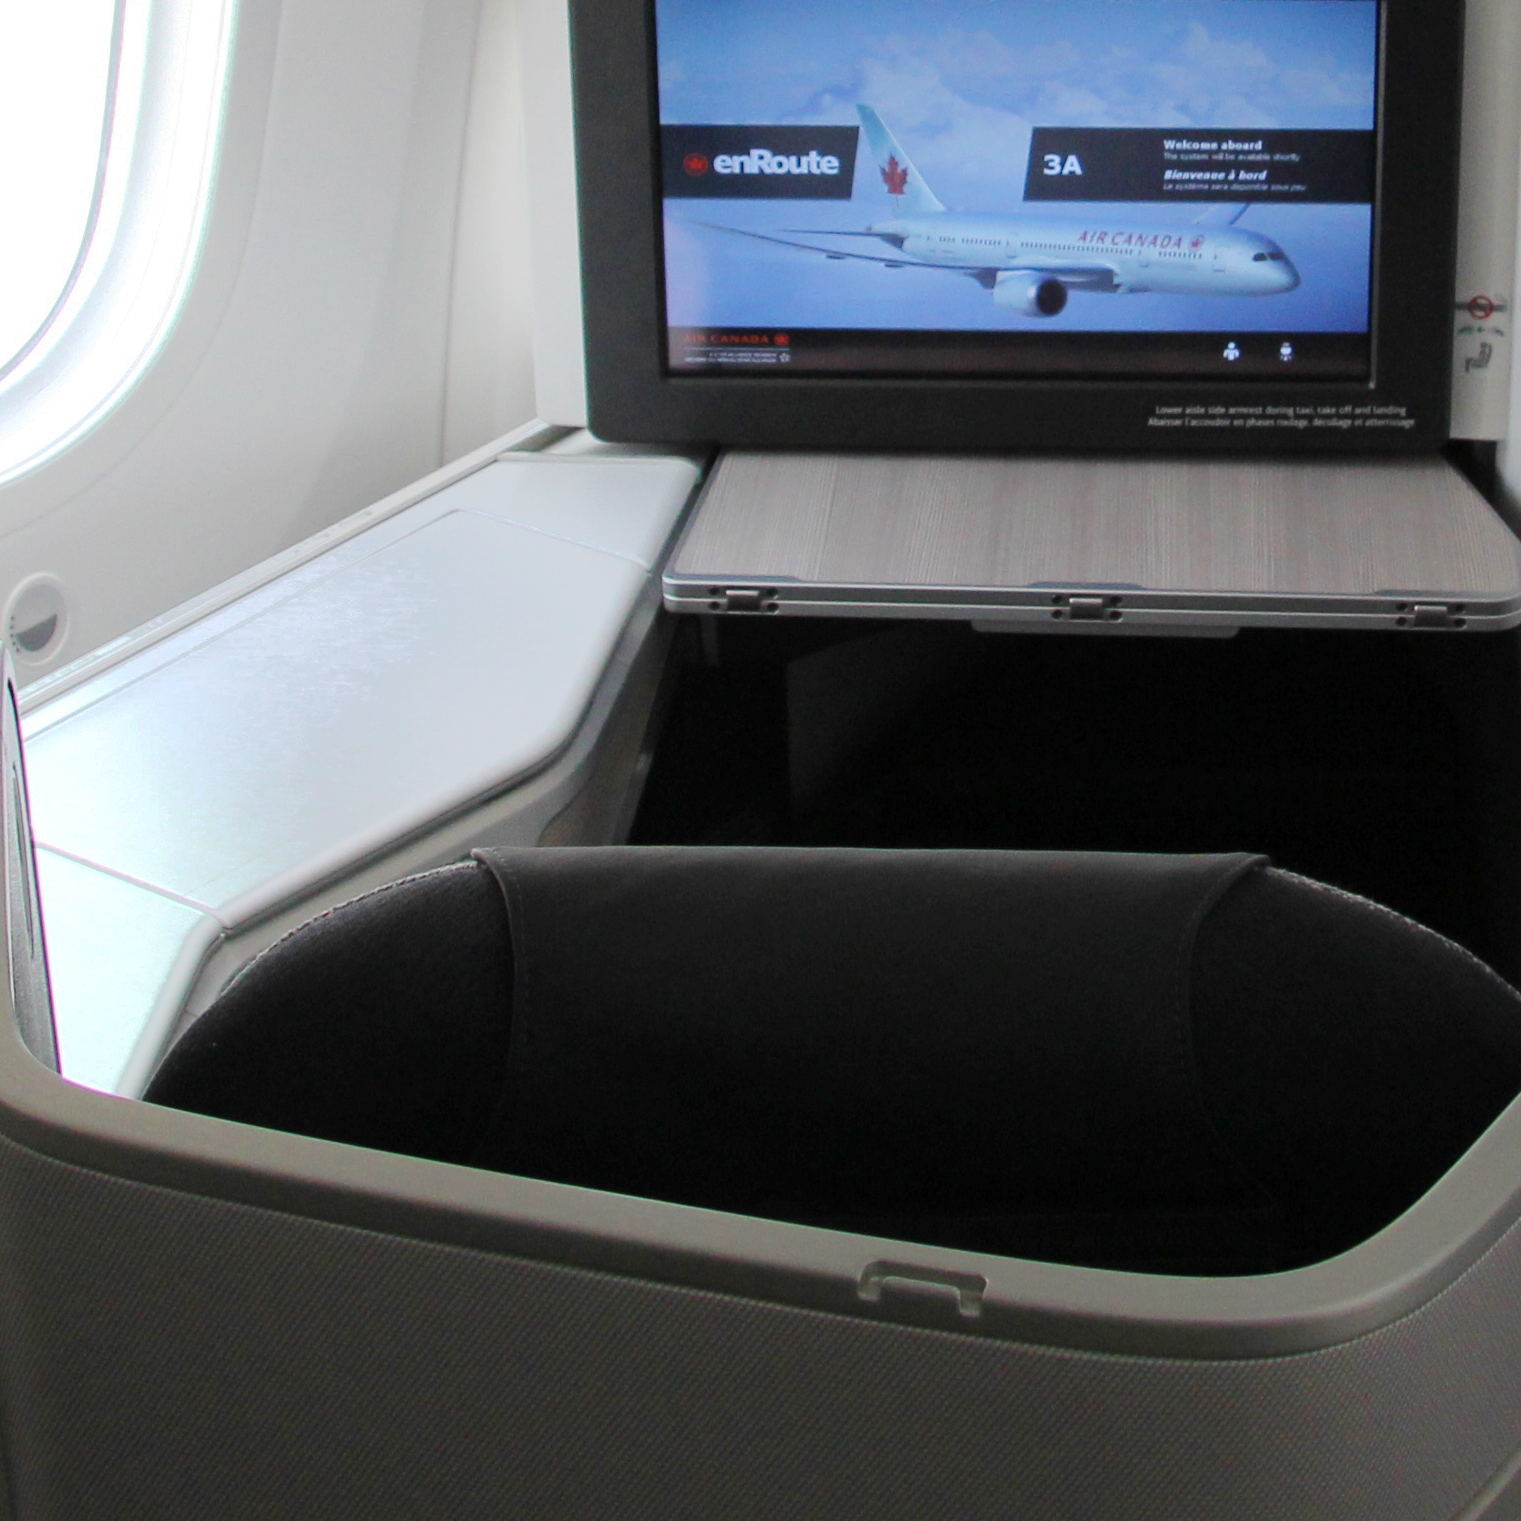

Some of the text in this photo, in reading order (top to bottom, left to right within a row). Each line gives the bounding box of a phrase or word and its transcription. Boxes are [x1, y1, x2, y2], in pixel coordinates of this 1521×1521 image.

[1163, 139, 1263, 151] Welcome aboard
[713, 148, 840, 175] enRoute
[1043, 153, 1083, 176] 3A
[1164, 168, 1268, 181] Bienvenue à bord
[1078, 230, 1183, 249] AIR CANADA
